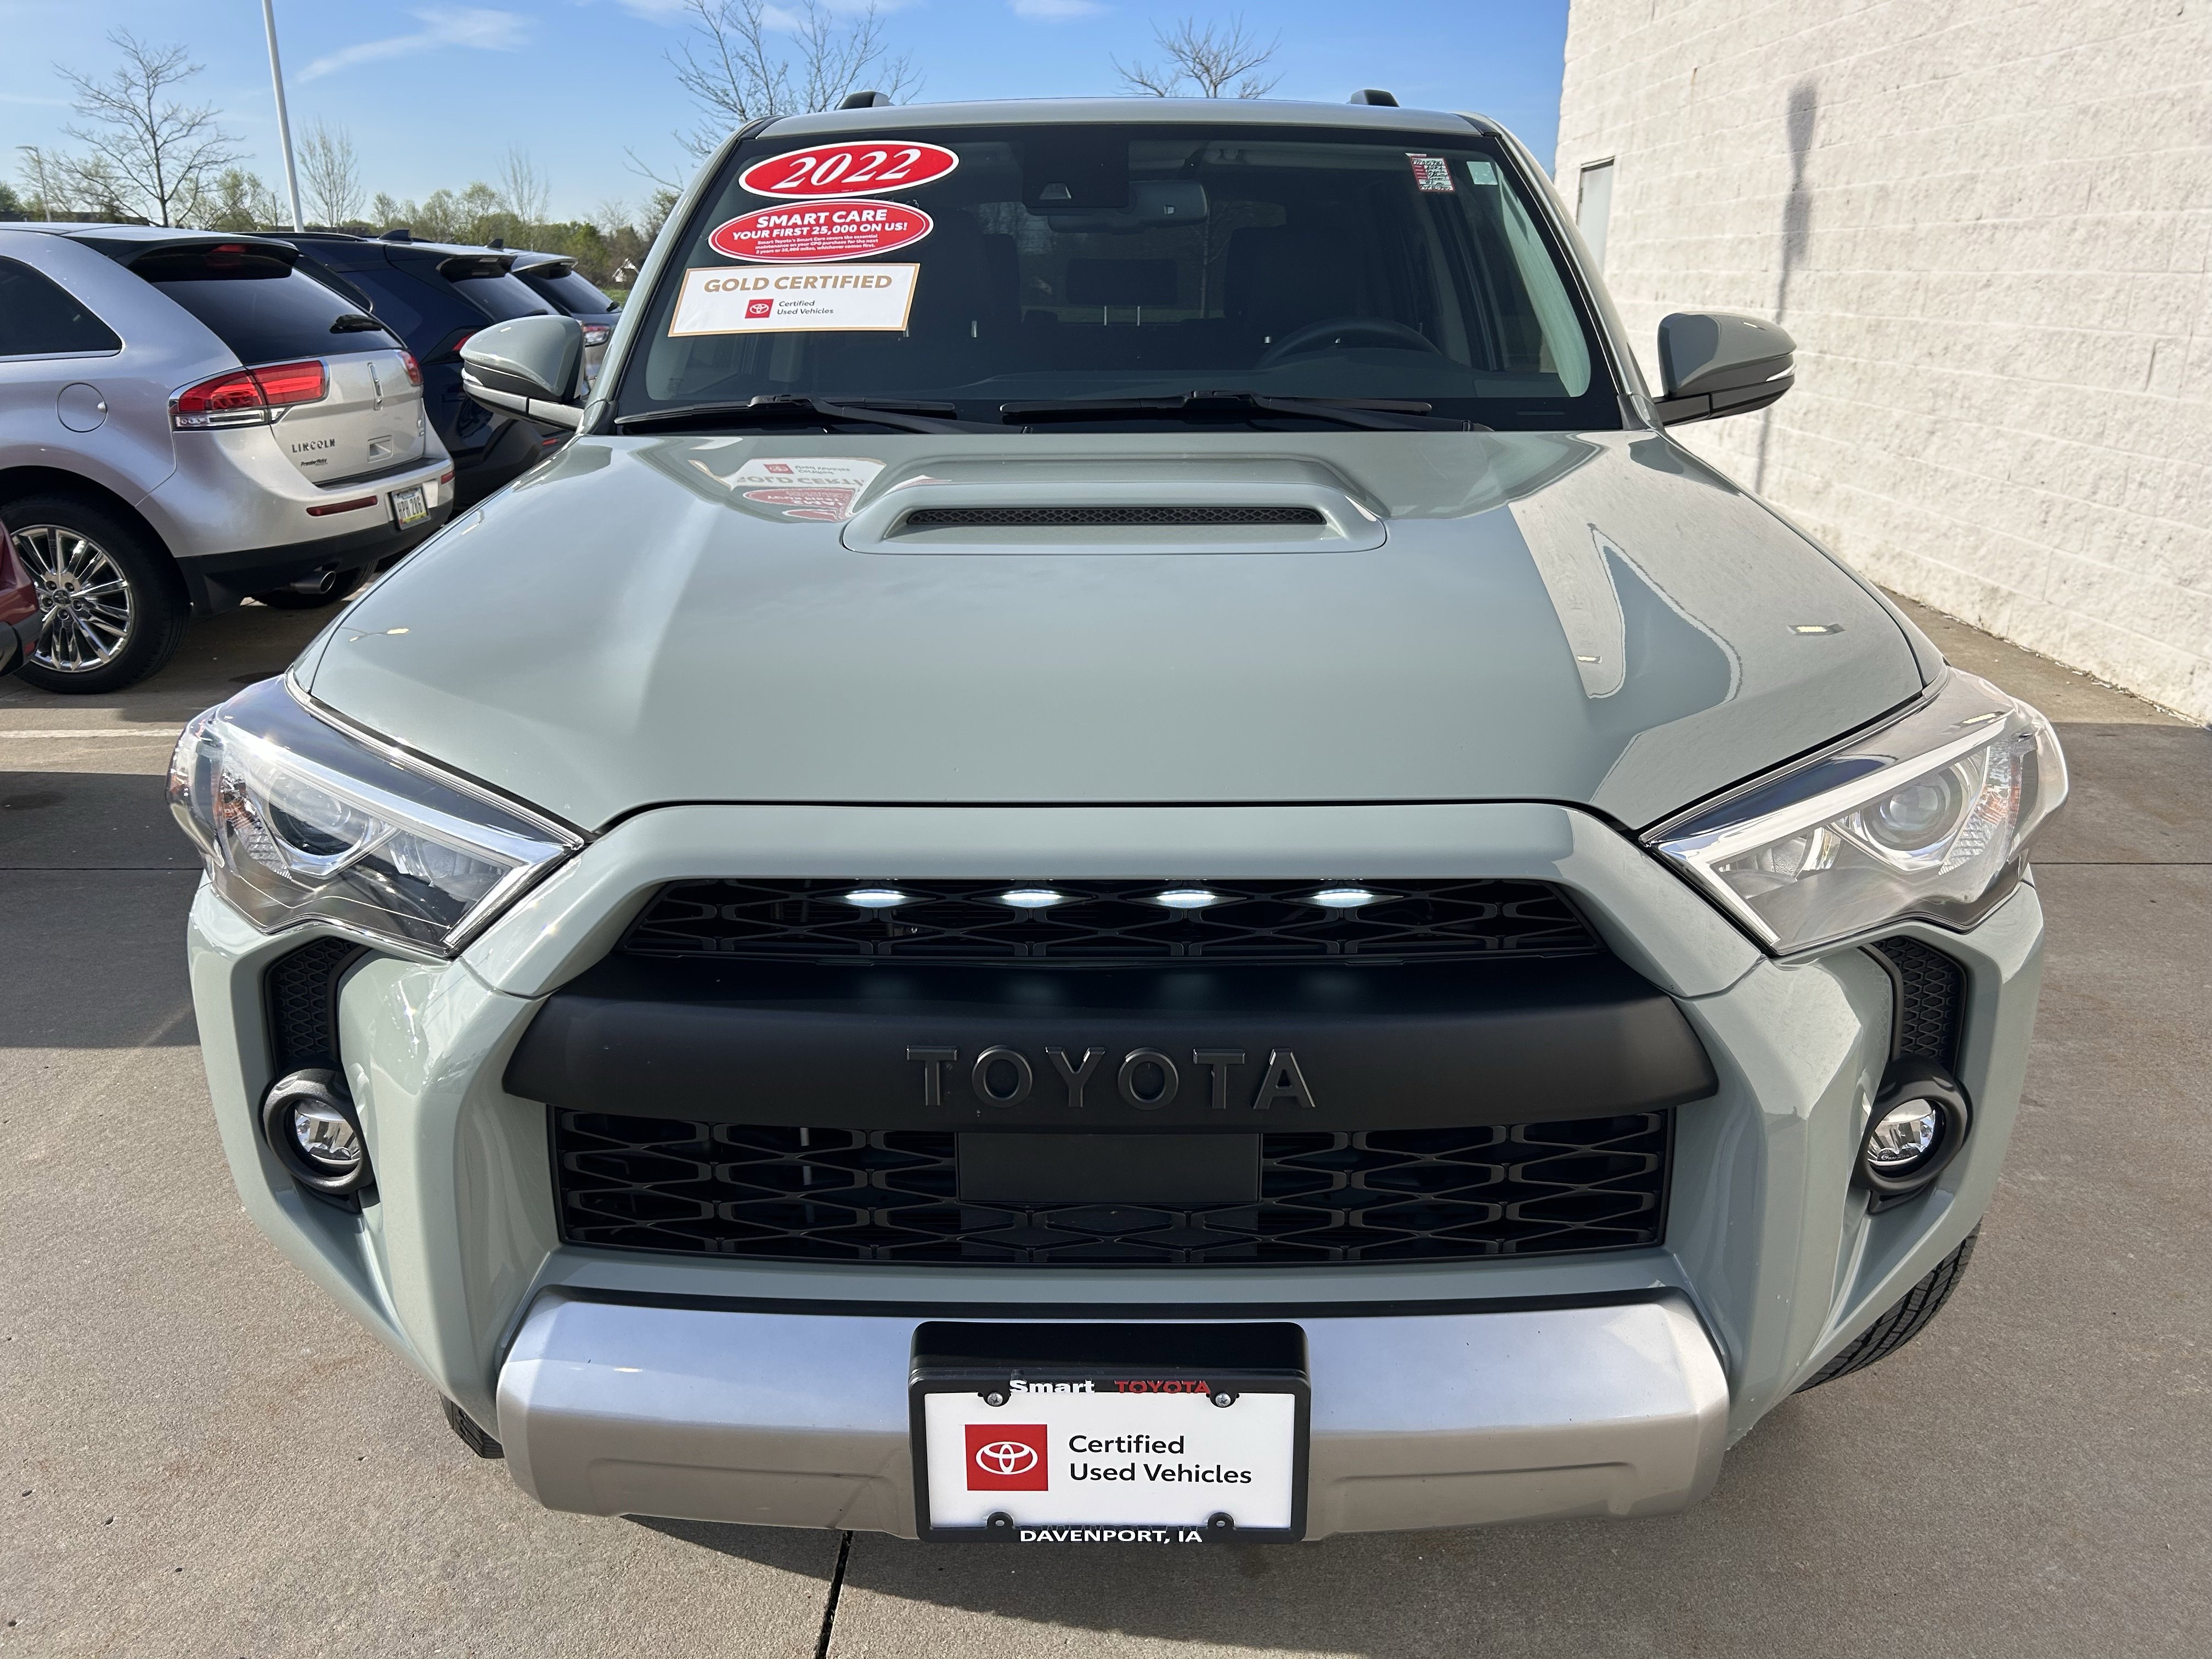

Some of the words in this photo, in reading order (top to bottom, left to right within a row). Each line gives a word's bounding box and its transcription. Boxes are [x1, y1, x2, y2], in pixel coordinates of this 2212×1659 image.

[770, 148, 922, 190] 2022
[756, 212, 830, 228] SMART
[832, 209, 888, 223] CARE
[732, 229, 770, 241] YOUR
[772, 227, 808, 238] FIRST
[811, 224, 857, 236] 25,000
[860, 223, 882, 232] ON
[885, 222, 908, 232] US!
[704, 276, 769, 293] GOLD
[774, 275, 892, 290] CERTIFIED
[292, 438, 336, 453] LINCOLN
[906, 1044, 1316, 1110] TOYOTA
[1009, 1379, 1095, 1393] Smart
[1114, 1380, 1211, 1394] TOYOTA
[1069, 1434, 1184, 1454] Certified
[1070, 1463, 1136, 1481] Used
[1143, 1464, 1252, 1484] Vehicles
[1020, 1530, 1170, 1544] DAVENPORT,
[1178, 1530, 1203, 1542] IA
